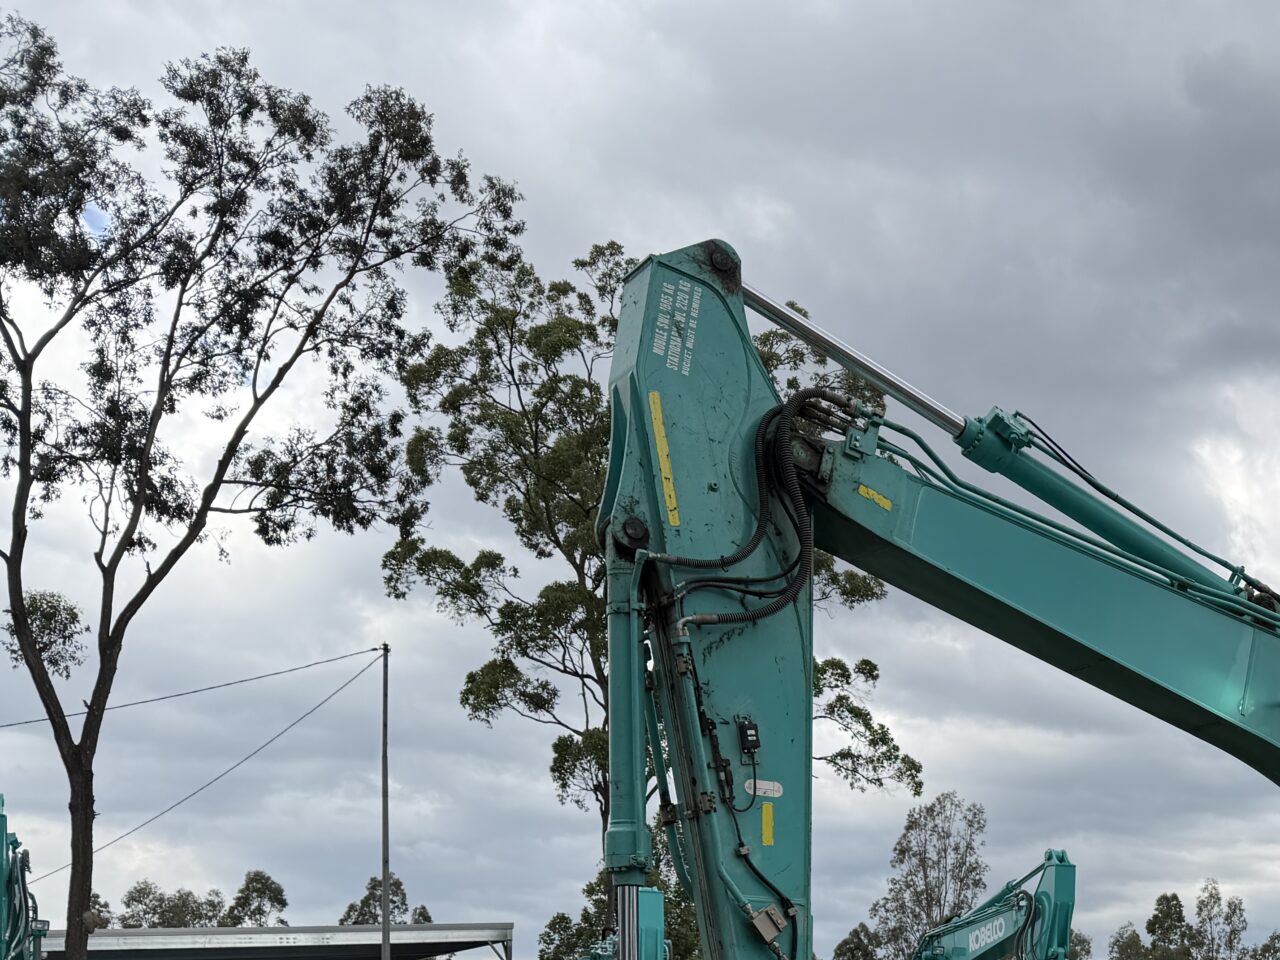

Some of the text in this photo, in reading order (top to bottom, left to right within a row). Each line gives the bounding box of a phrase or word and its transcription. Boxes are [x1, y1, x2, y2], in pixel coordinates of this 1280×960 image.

[661, 282, 675, 294] KG
[678, 280, 691, 292] KG
[656, 312, 670, 329] SWL
[681, 286, 702, 376] BUCKET MUST BE REMOVED
[652, 329, 667, 356] MOBILE
[968, 917, 1005, 953] KOBELCO
